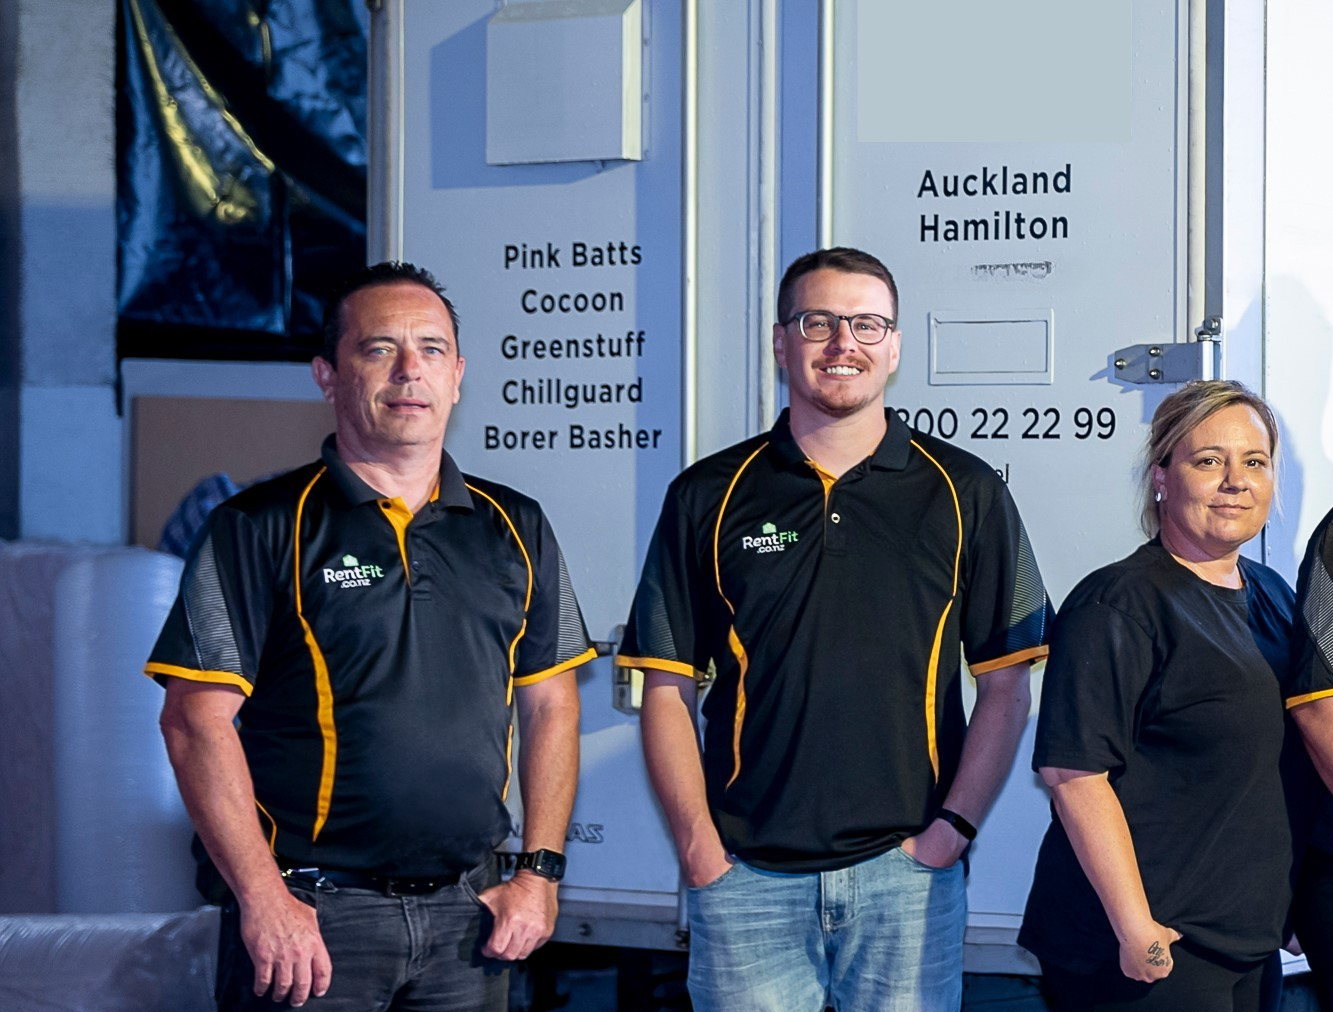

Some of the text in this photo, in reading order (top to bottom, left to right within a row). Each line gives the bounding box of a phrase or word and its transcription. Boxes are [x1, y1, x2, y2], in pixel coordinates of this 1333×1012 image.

[917, 164, 1072, 198] Auckland
[920, 210, 1069, 242] Hamilton
[504, 241, 643, 269] Pink Batts
[521, 289, 624, 314] Cocoon
[501, 330, 646, 359] Greenstuff
[502, 376, 643, 409] Chillguard
[484, 423, 662, 450] Borer Basher
[971, 407, 1009, 440] 22
[1022, 407, 1061, 440] 22
[1074, 407, 1116, 440] 99
[742, 531, 799, 549] RentFit
[323, 565, 385, 583] RentFit
